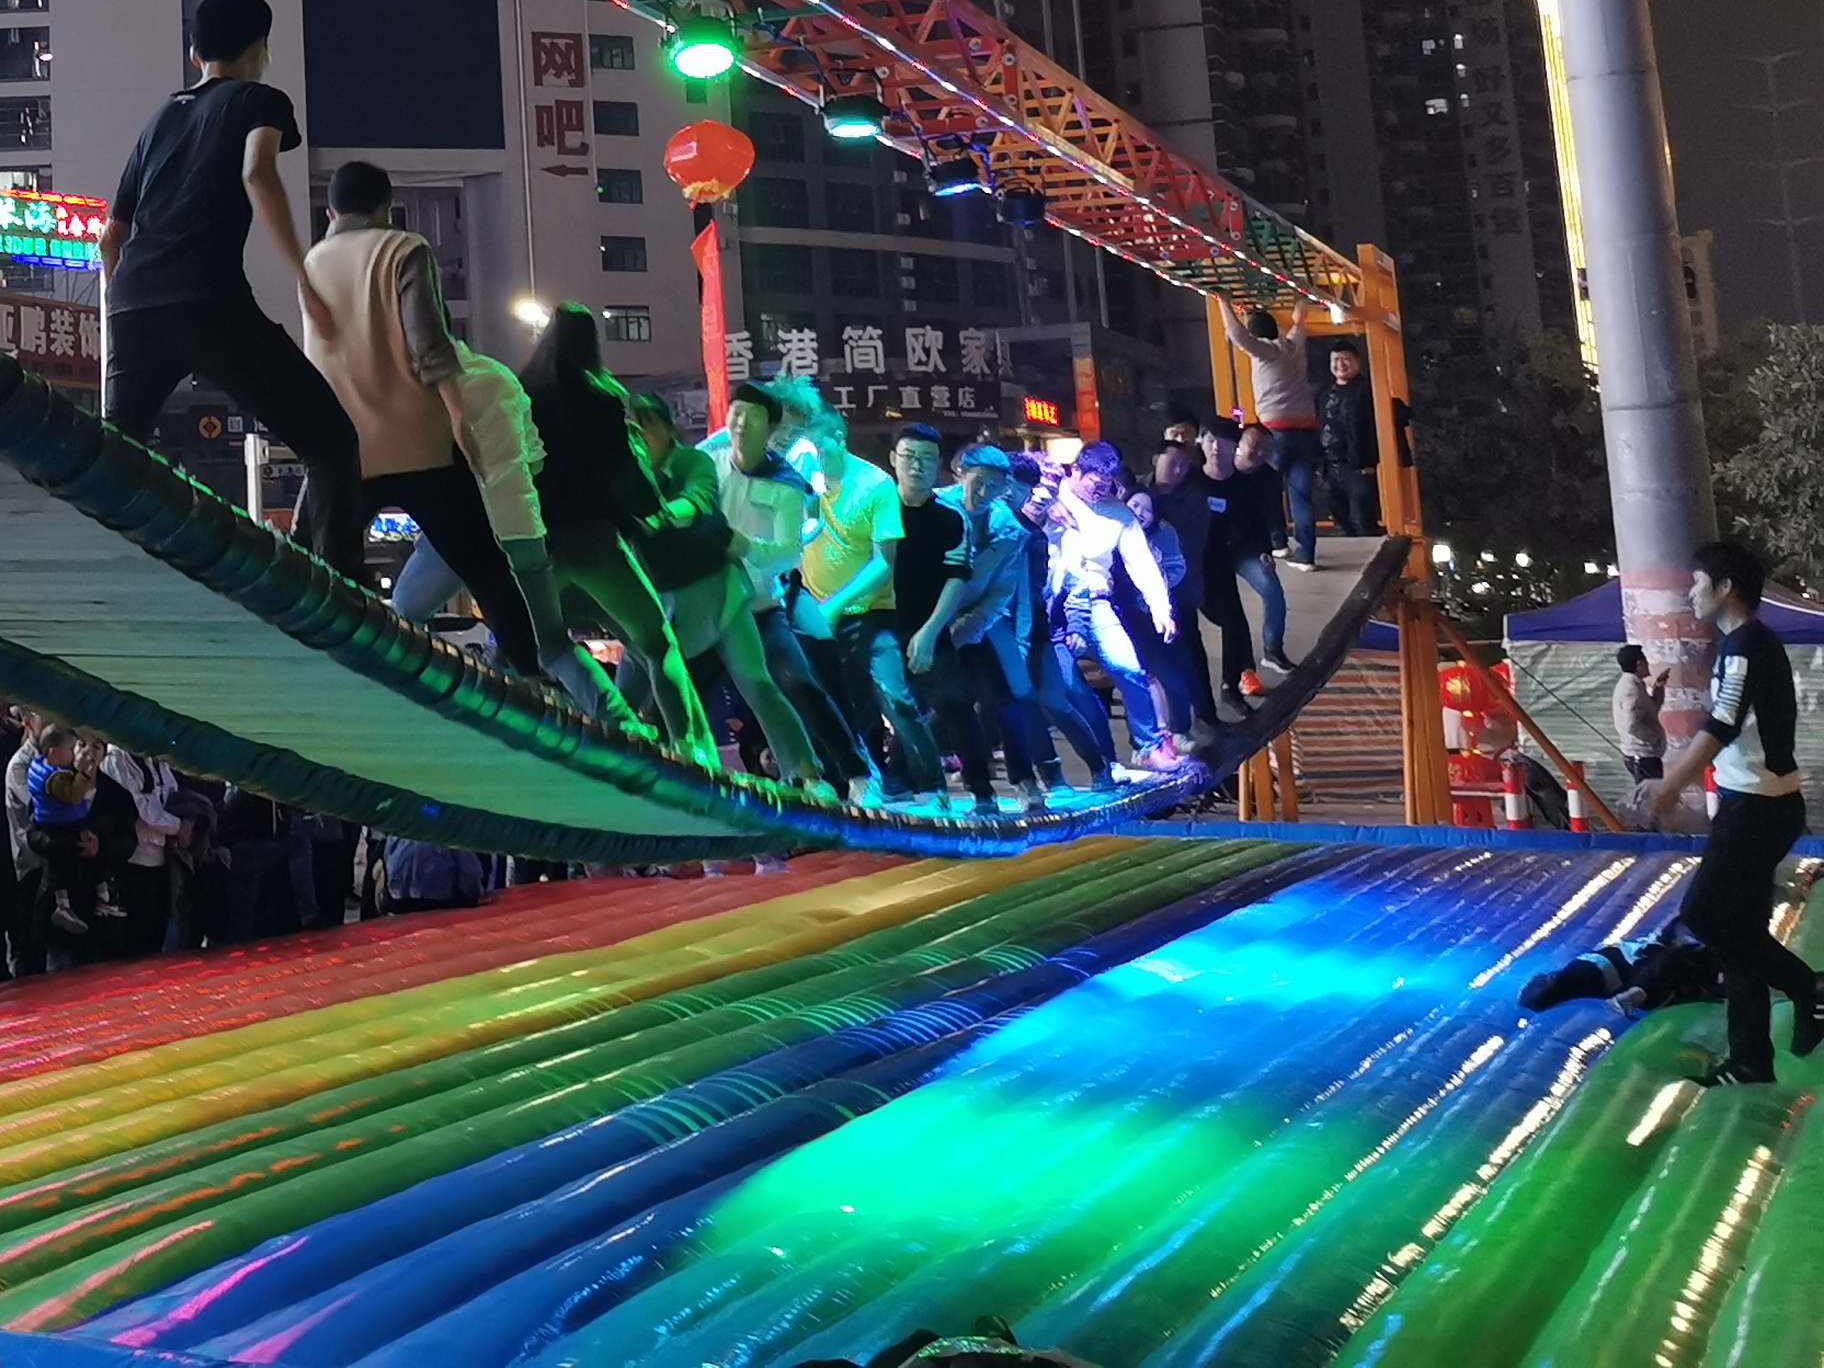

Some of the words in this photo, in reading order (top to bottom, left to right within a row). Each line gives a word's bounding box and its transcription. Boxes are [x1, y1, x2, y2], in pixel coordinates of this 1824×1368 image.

[531, 31, 590, 157] 网吧
[832, 384, 976, 409] 工厂直营店
